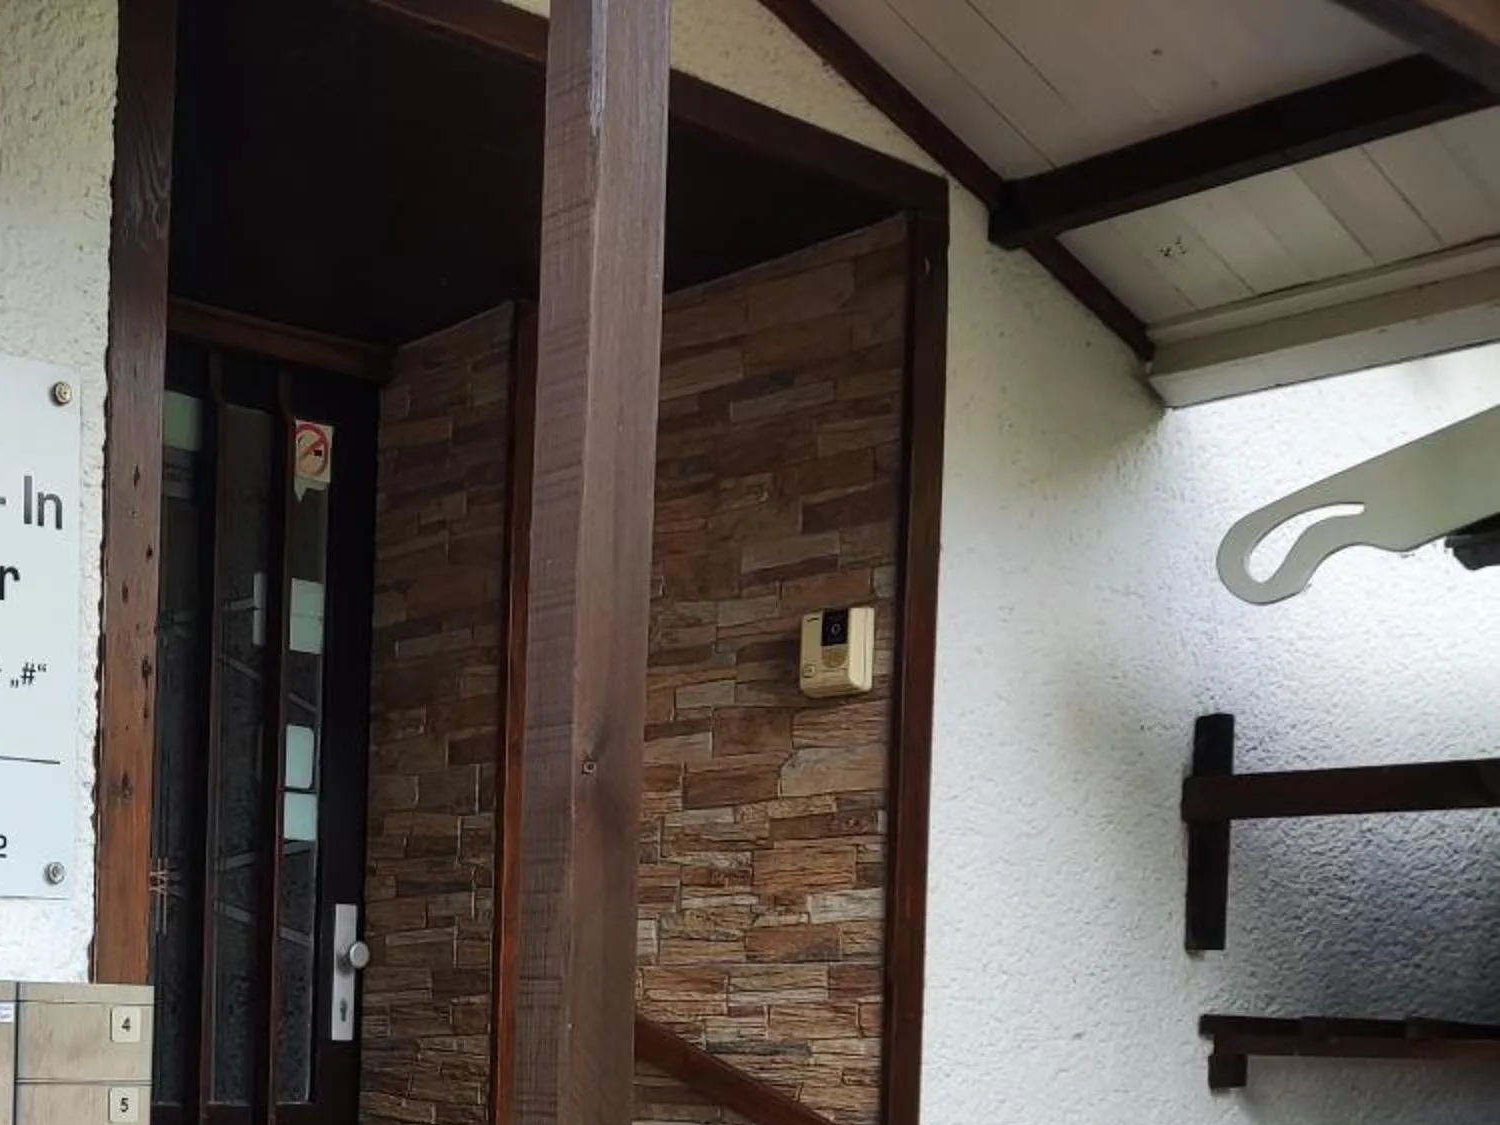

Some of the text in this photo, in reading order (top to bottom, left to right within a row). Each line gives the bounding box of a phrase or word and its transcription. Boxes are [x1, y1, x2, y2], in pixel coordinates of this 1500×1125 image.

[24, 476, 62, 530] In
[122, 1018, 130, 1031] 4
[121, 1098, 128, 1112] 5
